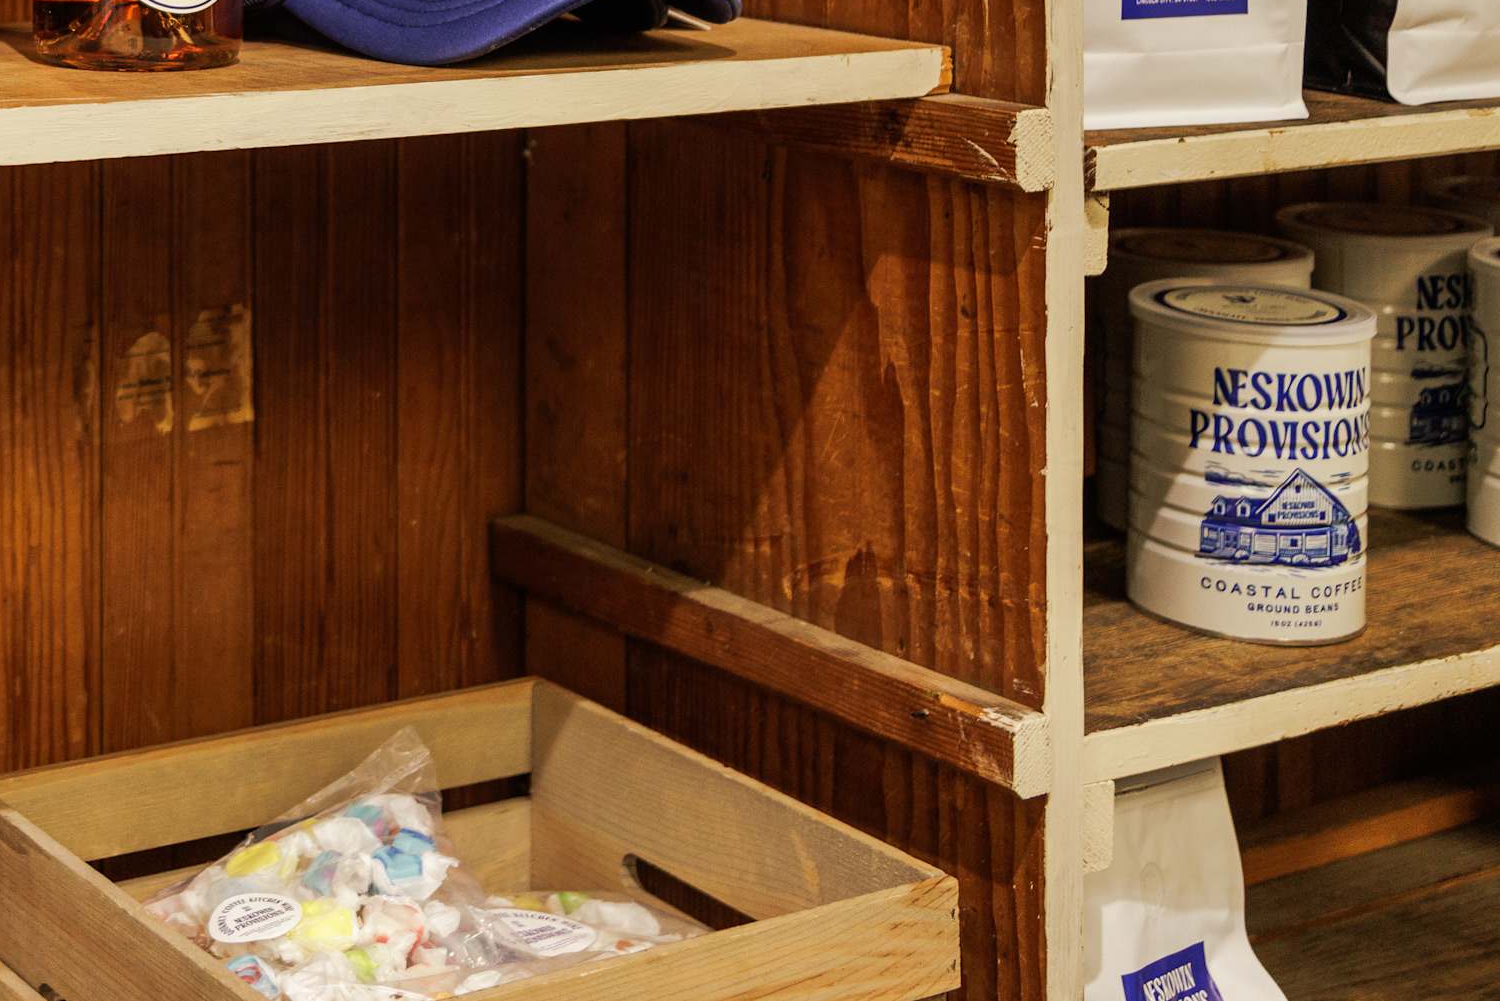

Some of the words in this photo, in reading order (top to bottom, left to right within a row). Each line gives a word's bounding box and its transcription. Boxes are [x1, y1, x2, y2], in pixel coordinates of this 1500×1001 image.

[1213, 366, 1366, 412] NESKOWIN
[1201, 576, 1300, 600] COASTAL
[1311, 576, 1363, 599] COFFEE
[1247, 602, 1300, 614] GROUND
[1305, 602, 1339, 614] BEANS
